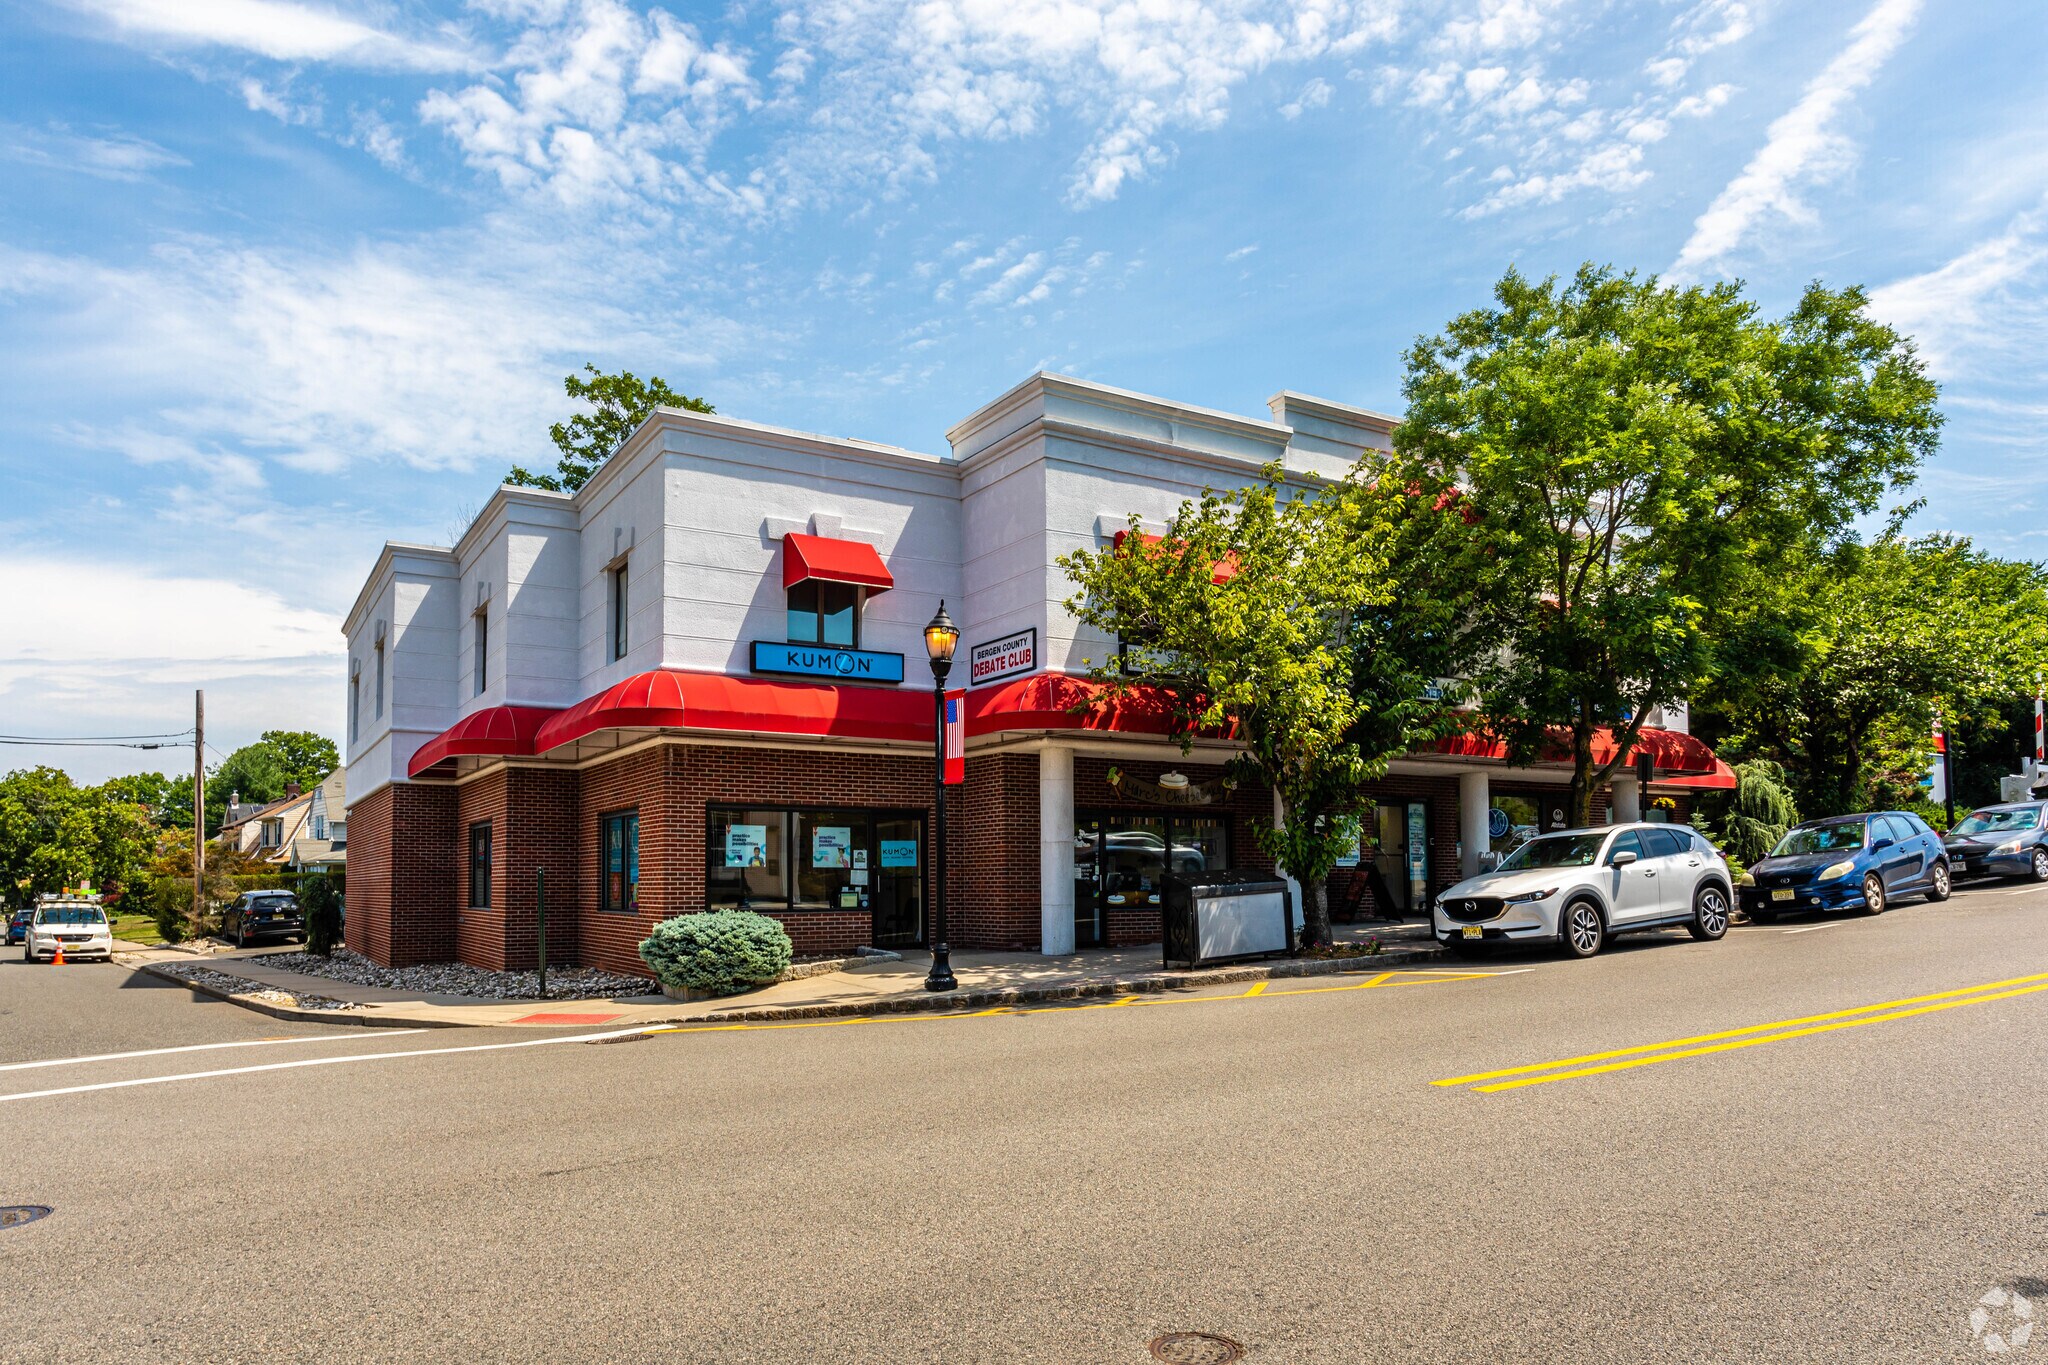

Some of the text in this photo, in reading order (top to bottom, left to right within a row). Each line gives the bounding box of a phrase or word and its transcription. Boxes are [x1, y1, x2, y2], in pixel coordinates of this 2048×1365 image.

[977, 637, 1028, 660] BERGEN COUNTY
[787, 651, 870, 674] KUMON
[974, 648, 1032, 677] DEBATE CLUB
[882, 847, 914, 856] KUMON
